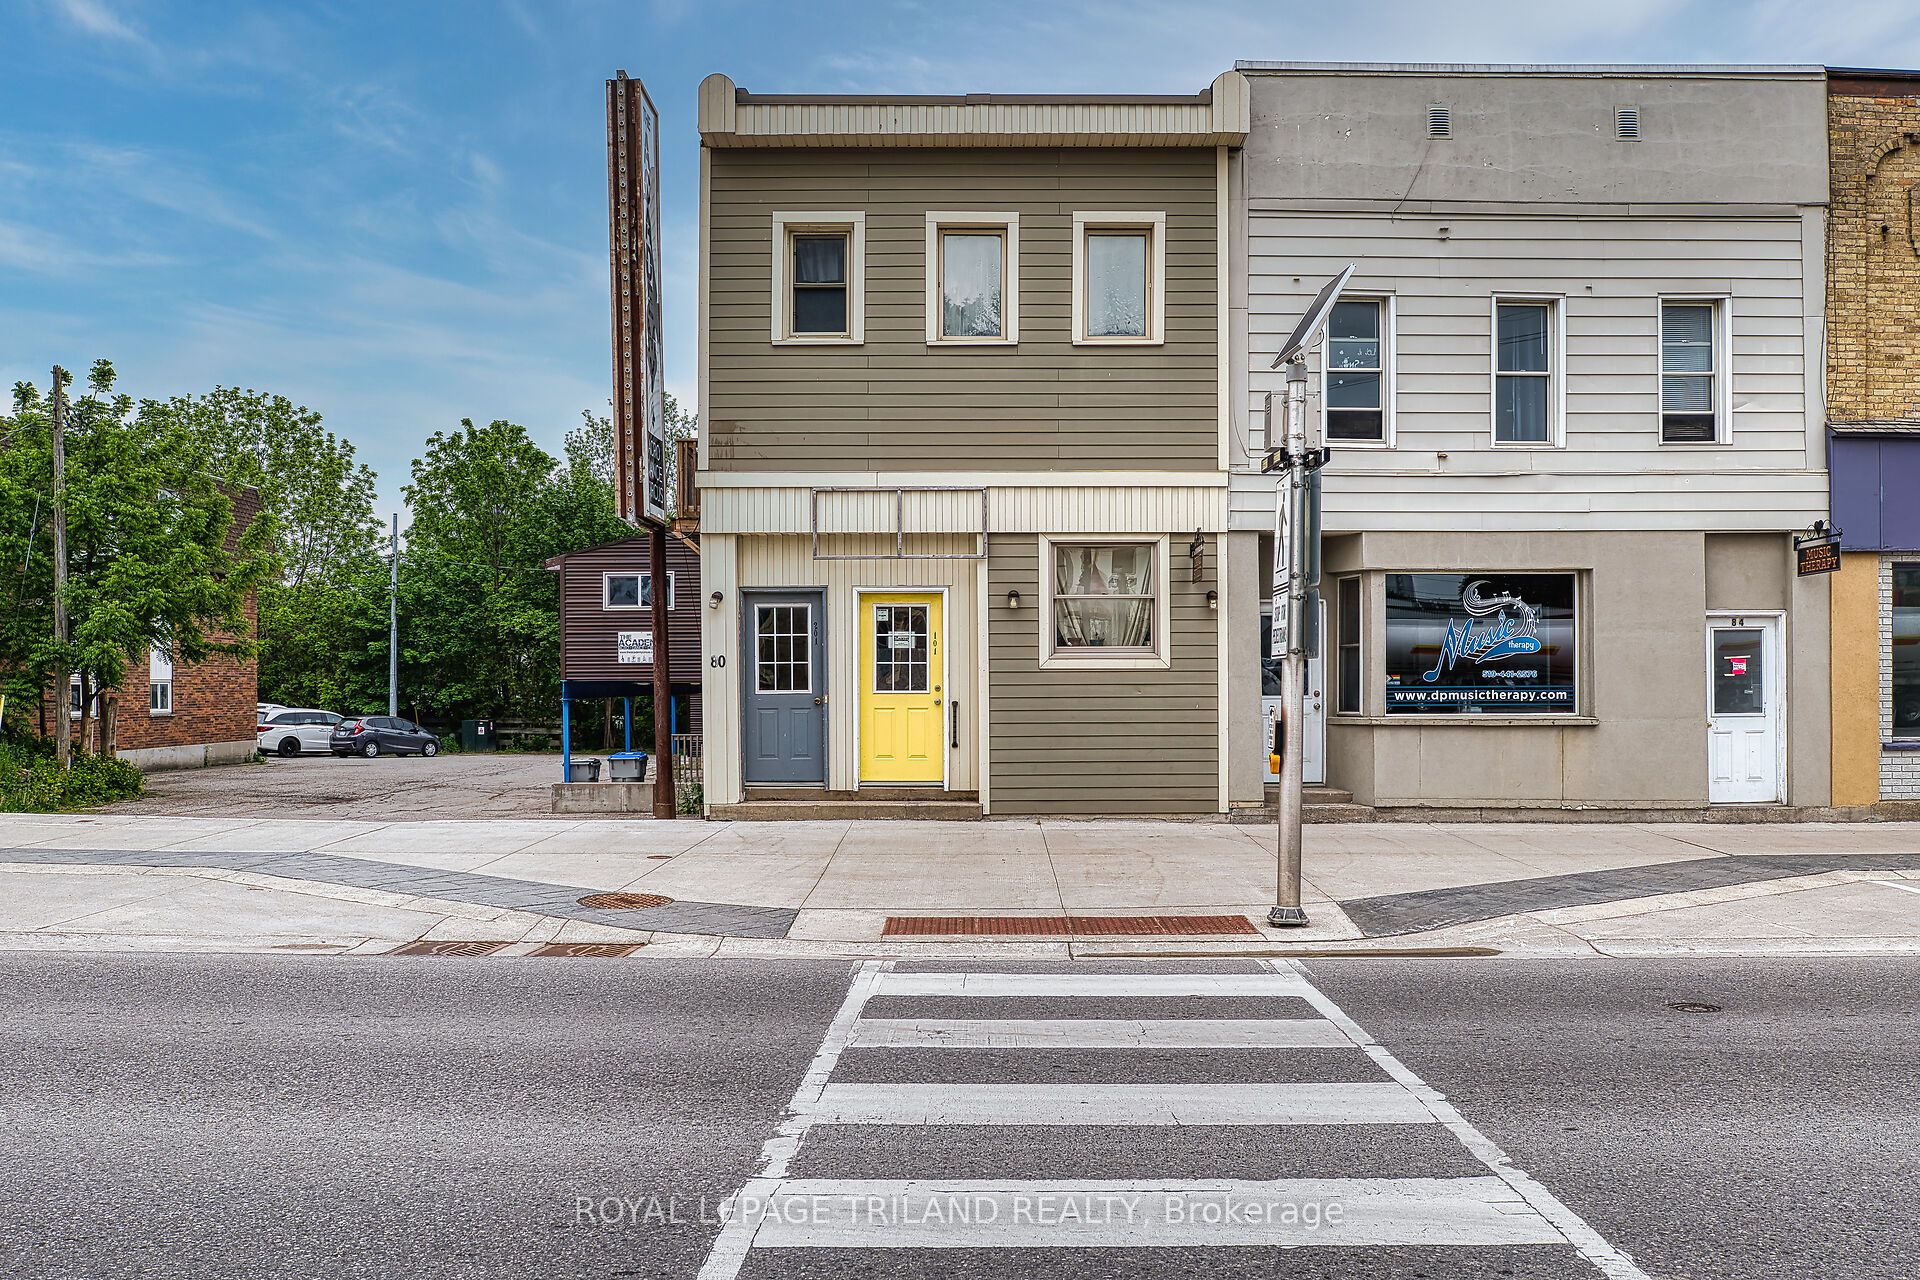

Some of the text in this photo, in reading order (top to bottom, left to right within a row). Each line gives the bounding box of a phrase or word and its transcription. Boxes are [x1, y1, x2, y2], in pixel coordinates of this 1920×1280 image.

[1806, 545, 1832, 560] MUSIC
[1800, 557, 1838, 573] THERAPY
[1731, 618, 1745, 627] 84
[1422, 608, 1516, 682] Music
[1508, 640, 1535, 651] therapy
[710, 654, 726, 668] 80
[1394, 689, 1568, 702] www.dpmusictherapy.com
